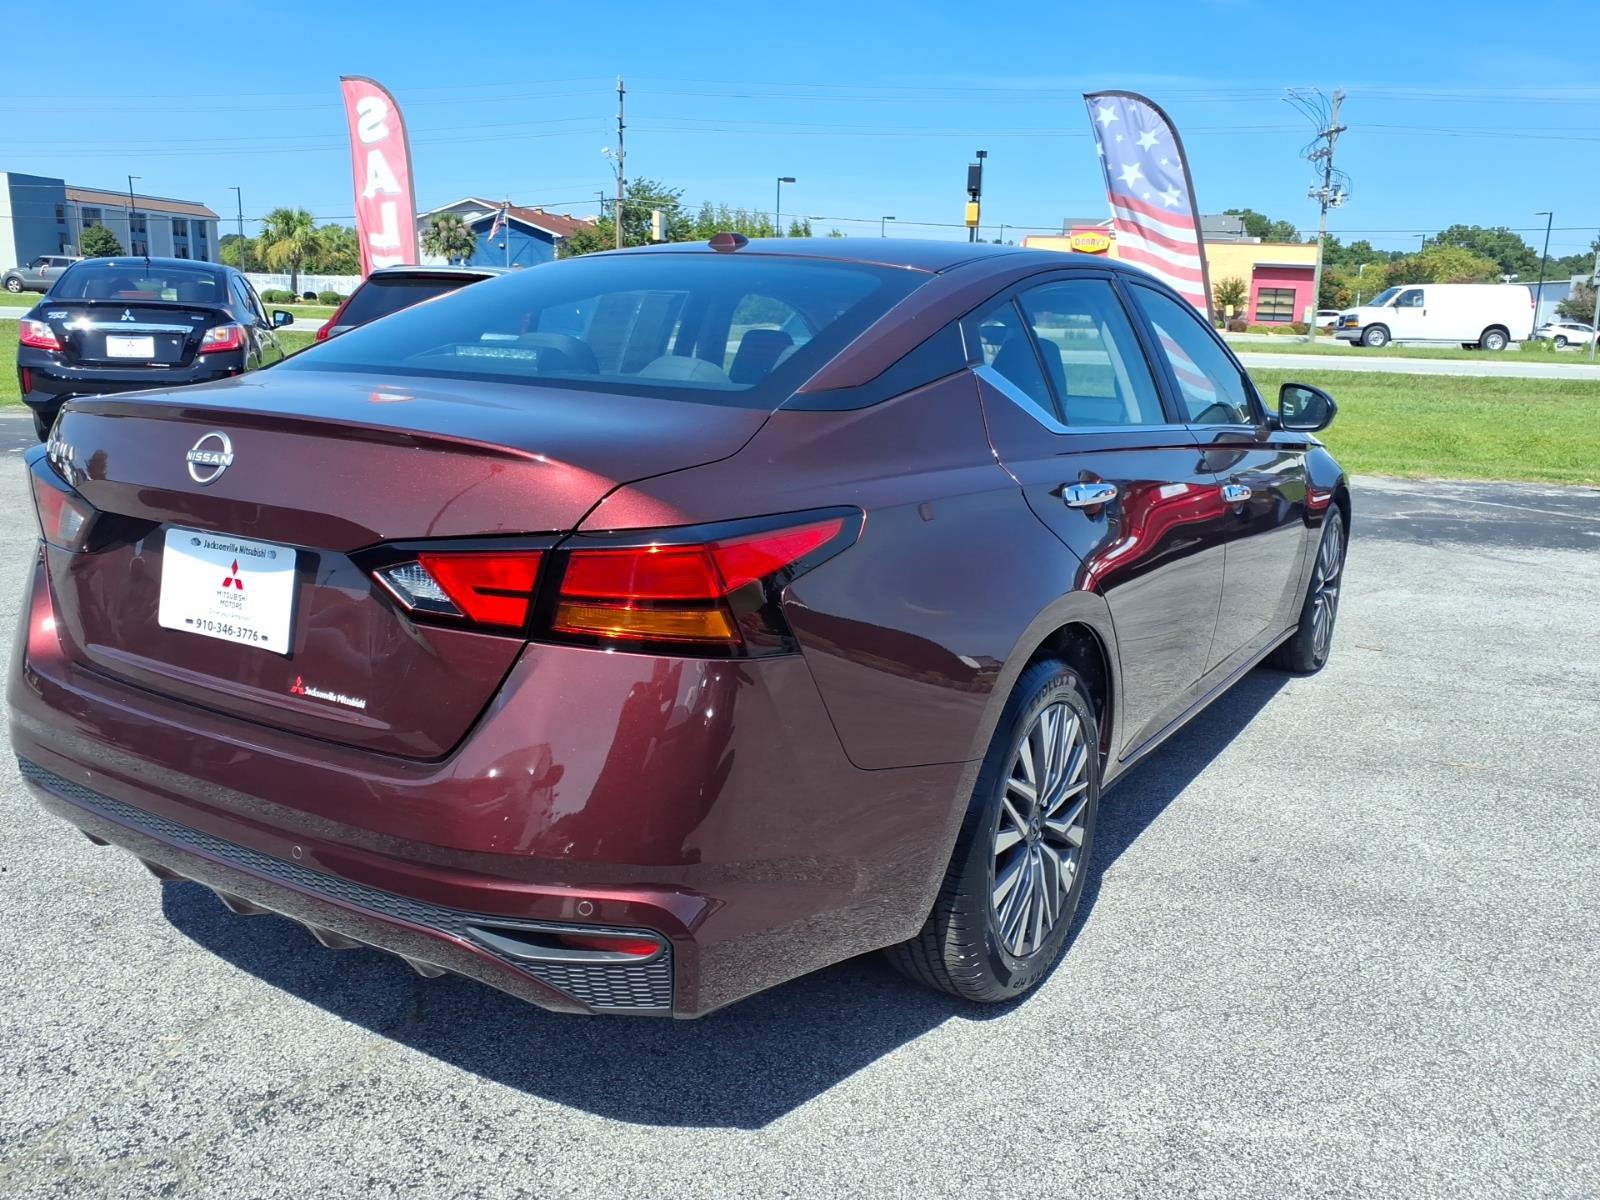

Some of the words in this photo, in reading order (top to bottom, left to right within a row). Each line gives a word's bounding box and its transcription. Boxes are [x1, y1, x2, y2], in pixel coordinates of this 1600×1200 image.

[186, 450, 234, 466] NISSAN
[204, 540, 238, 553] Jacksonville
[239, 545, 266, 558] Mitsubishi
[196, 618, 258, 641] 910-346-3776
